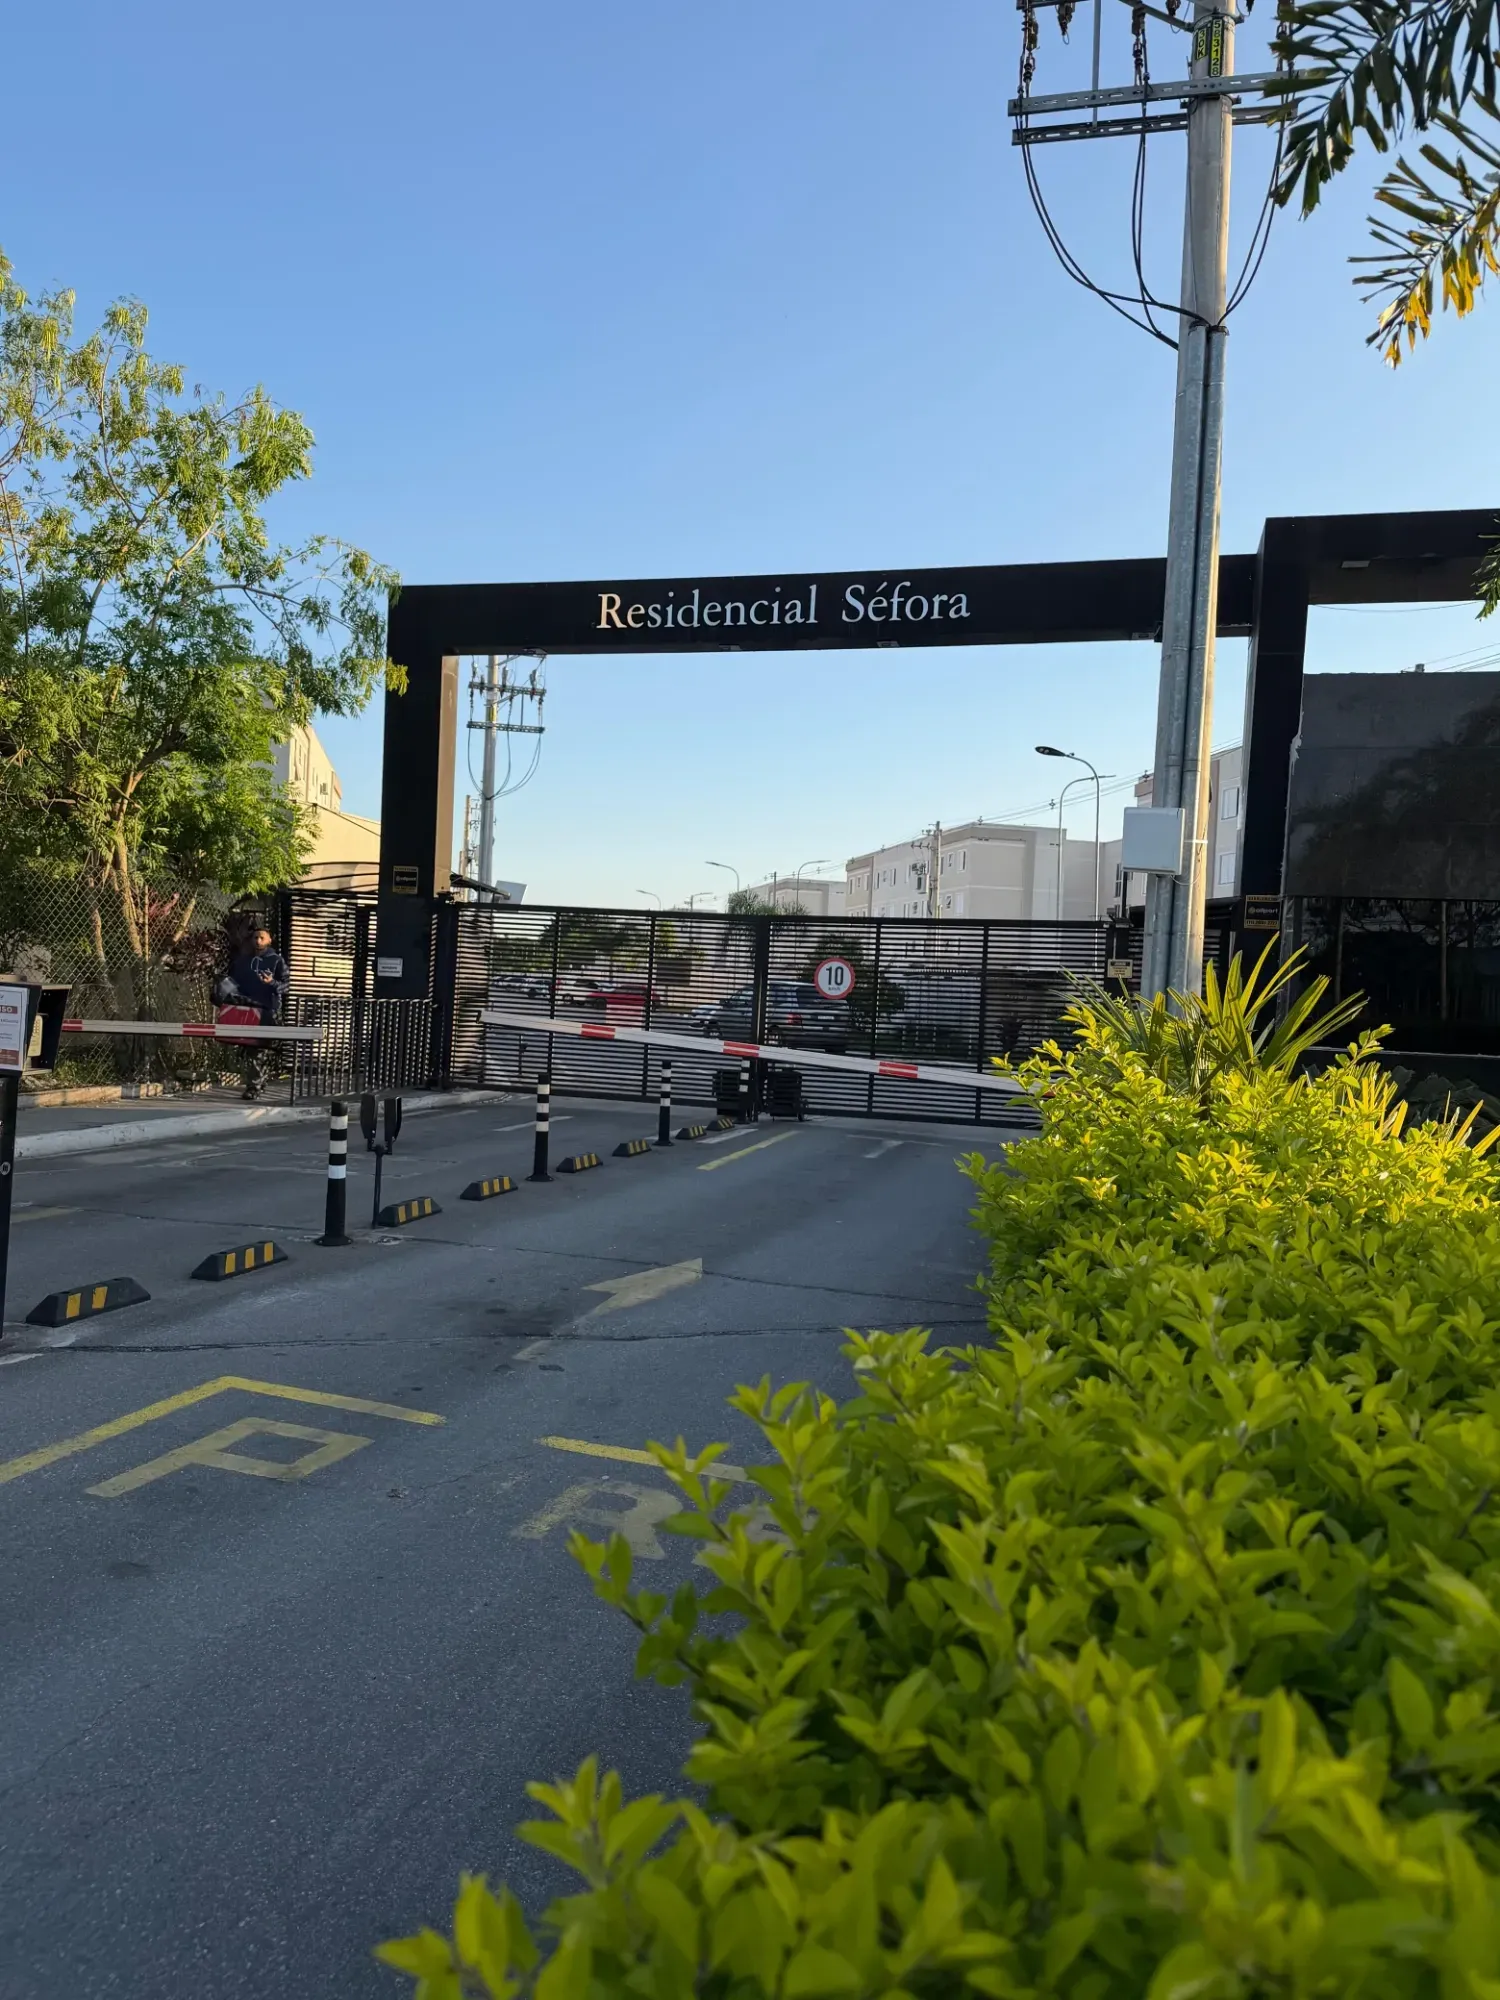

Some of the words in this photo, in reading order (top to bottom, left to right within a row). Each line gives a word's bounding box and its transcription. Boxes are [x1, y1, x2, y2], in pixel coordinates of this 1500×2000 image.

[1211, 20, 1221, 76] 583128
[596, 584, 818, 629] Residencial
[841, 581, 971, 622] Séfora
[826, 966, 844, 985] 10
